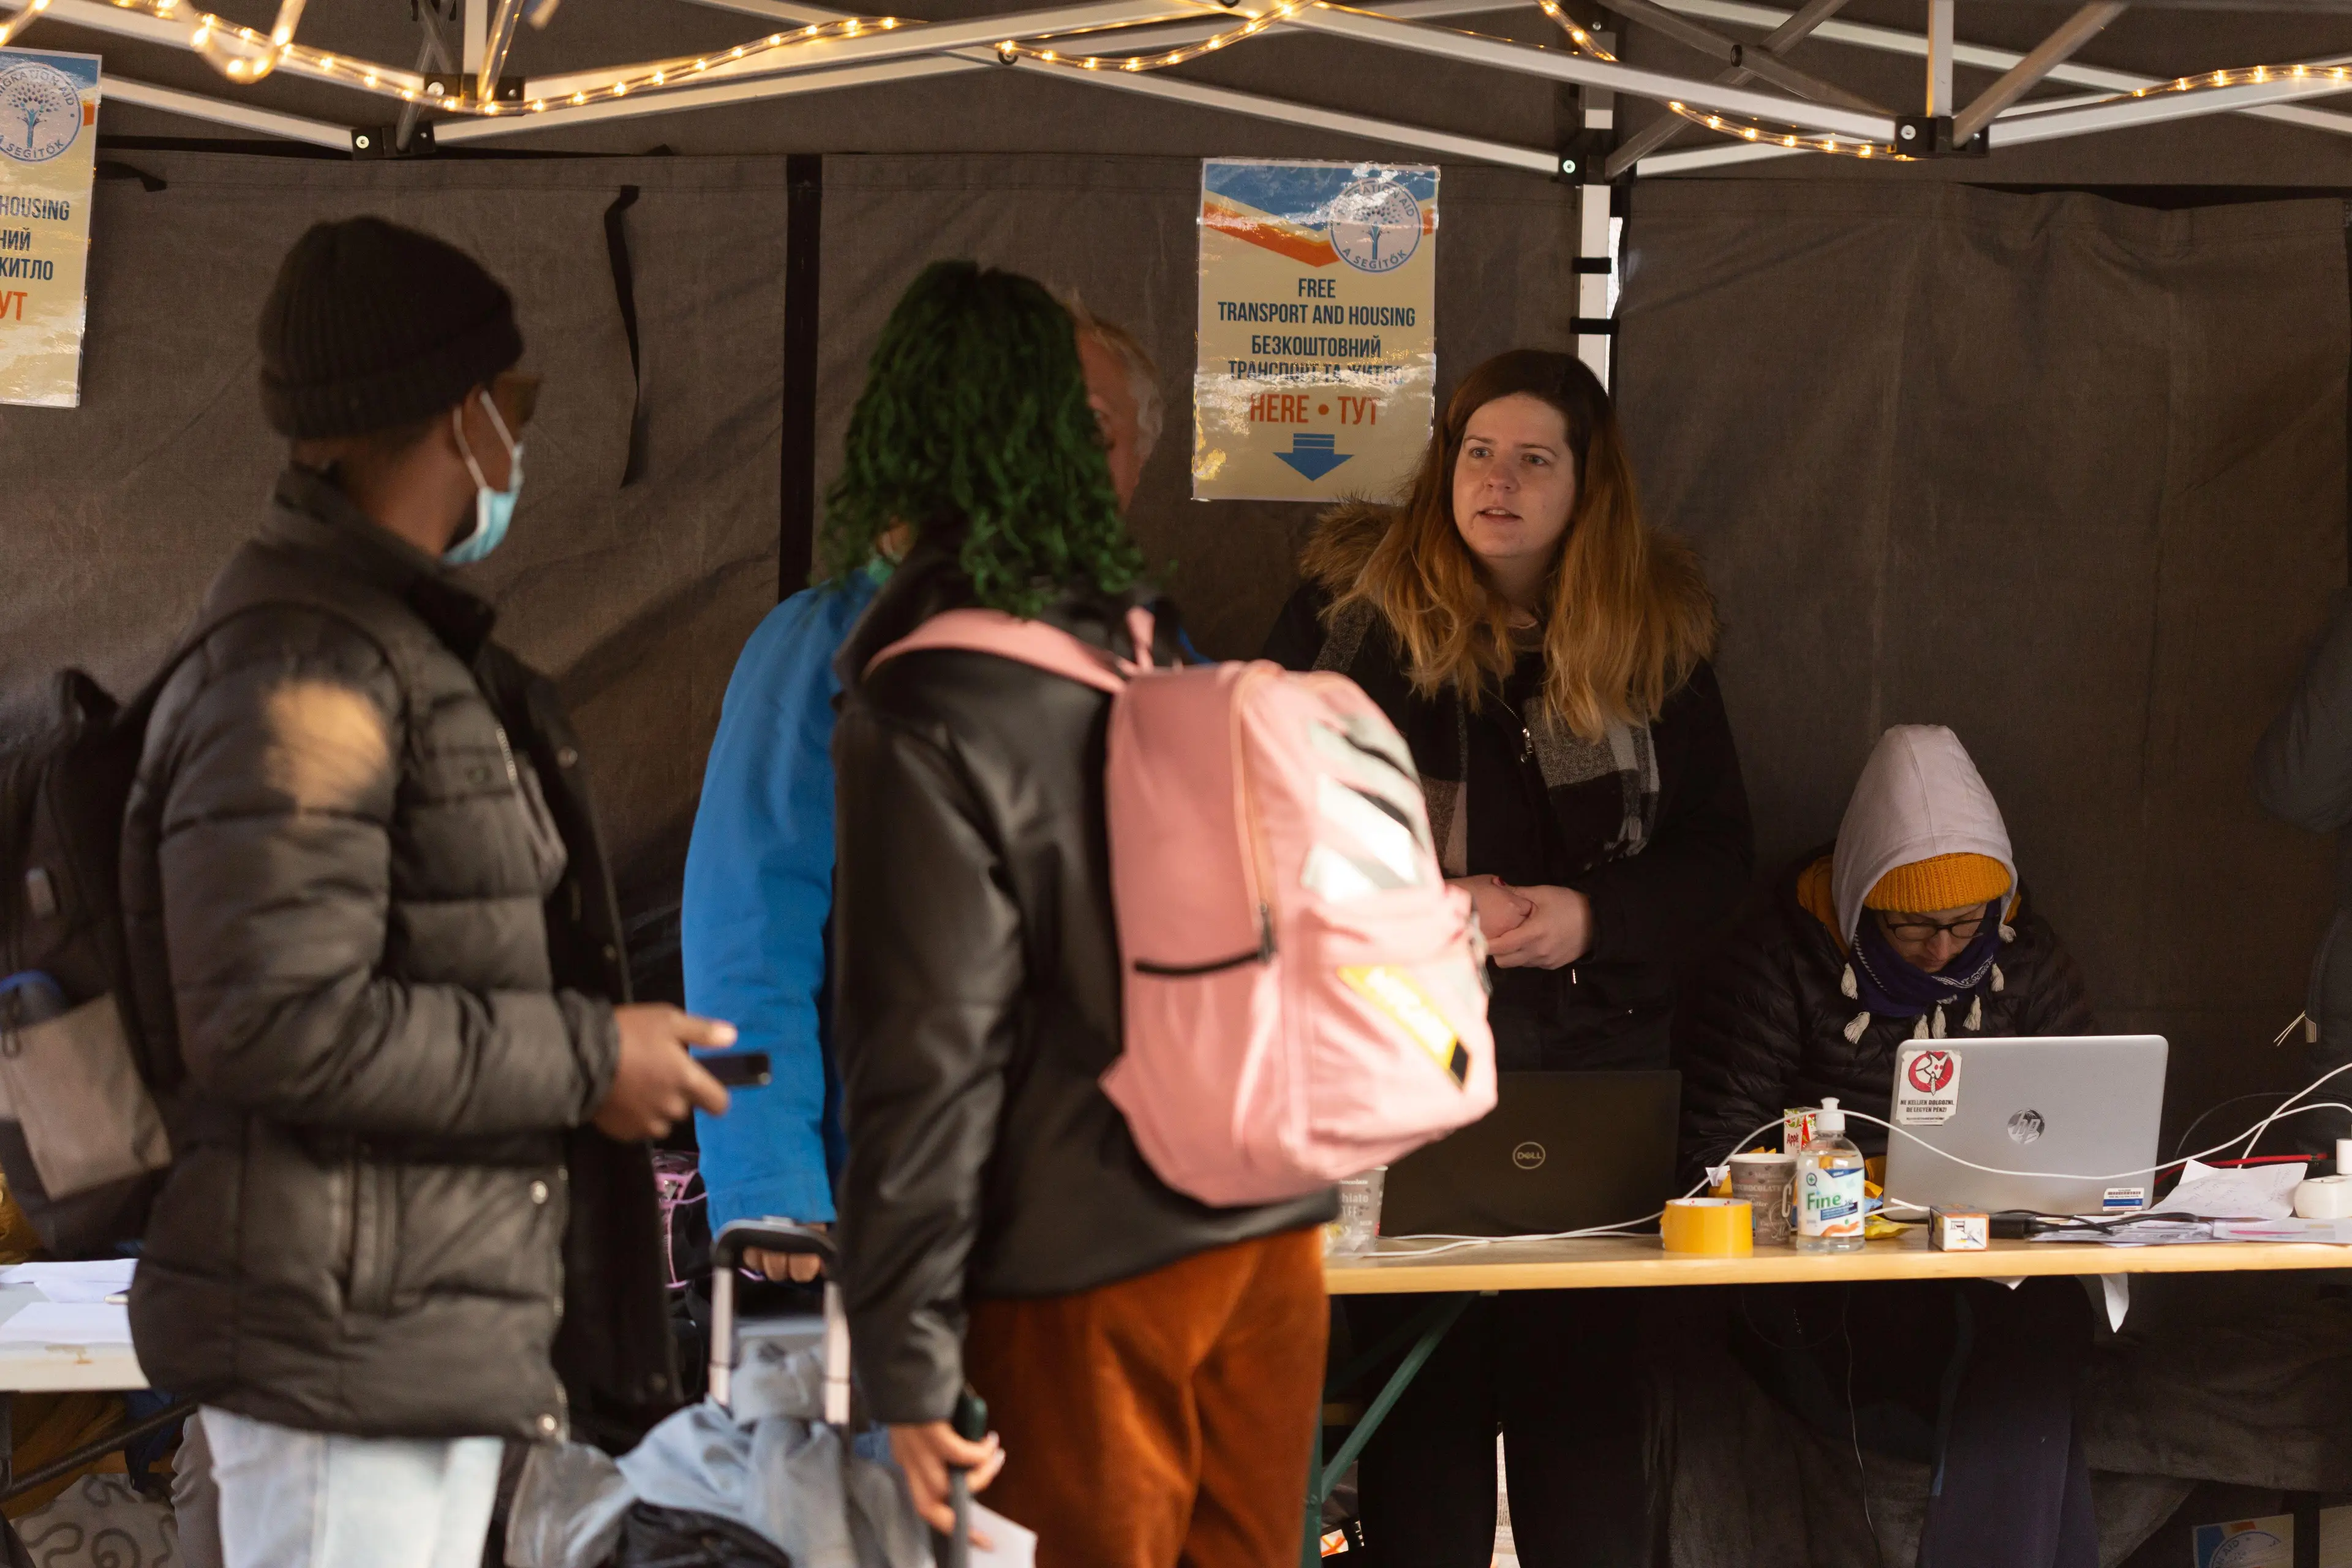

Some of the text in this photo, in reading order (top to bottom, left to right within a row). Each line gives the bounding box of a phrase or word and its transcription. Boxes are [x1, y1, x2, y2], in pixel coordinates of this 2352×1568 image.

[58, 86, 74, 105] AID
[0, 195, 70, 221] HOUSING
[1399, 198, 1414, 216] AID
[1342, 248, 1351, 257] A
[1298, 278, 1336, 298] FREE
[1218, 301, 1415, 327] TRANSPORT AND HOUSING
[1252, 334, 1381, 358] БЕЗКОШТОВНИЙ
[1250, 393, 1310, 424] HERE
[2011, 1110, 2041, 1144] hp
[1787, 1133, 1799, 1147] Apple
[1807, 1192, 1841, 1210] Fine
